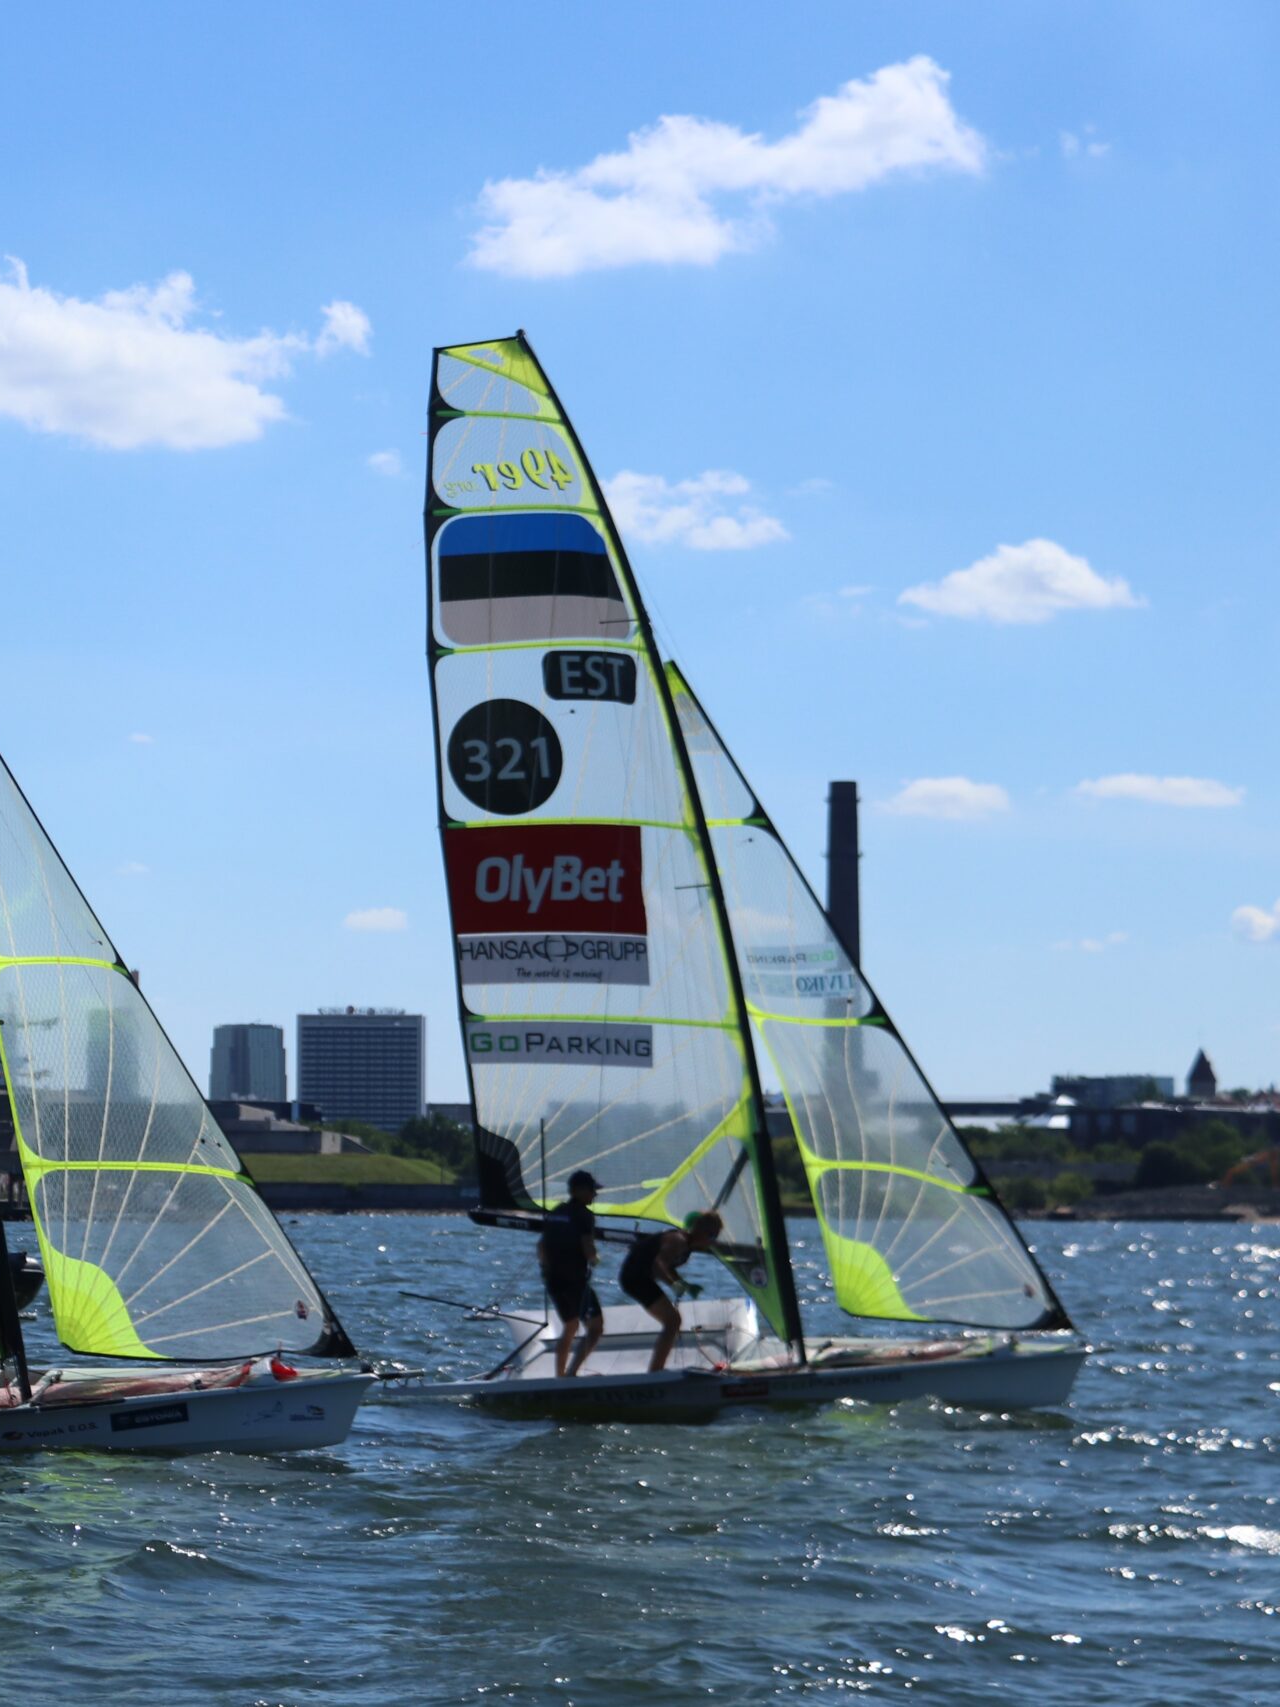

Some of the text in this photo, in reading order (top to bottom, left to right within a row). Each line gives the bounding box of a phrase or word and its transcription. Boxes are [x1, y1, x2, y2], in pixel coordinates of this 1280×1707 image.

[559, 654, 625, 697] EST
[462, 736, 552, 782] 321
[475, 854, 625, 914] OlyBet
[458, 940, 647, 962] HANSA GRUPP
